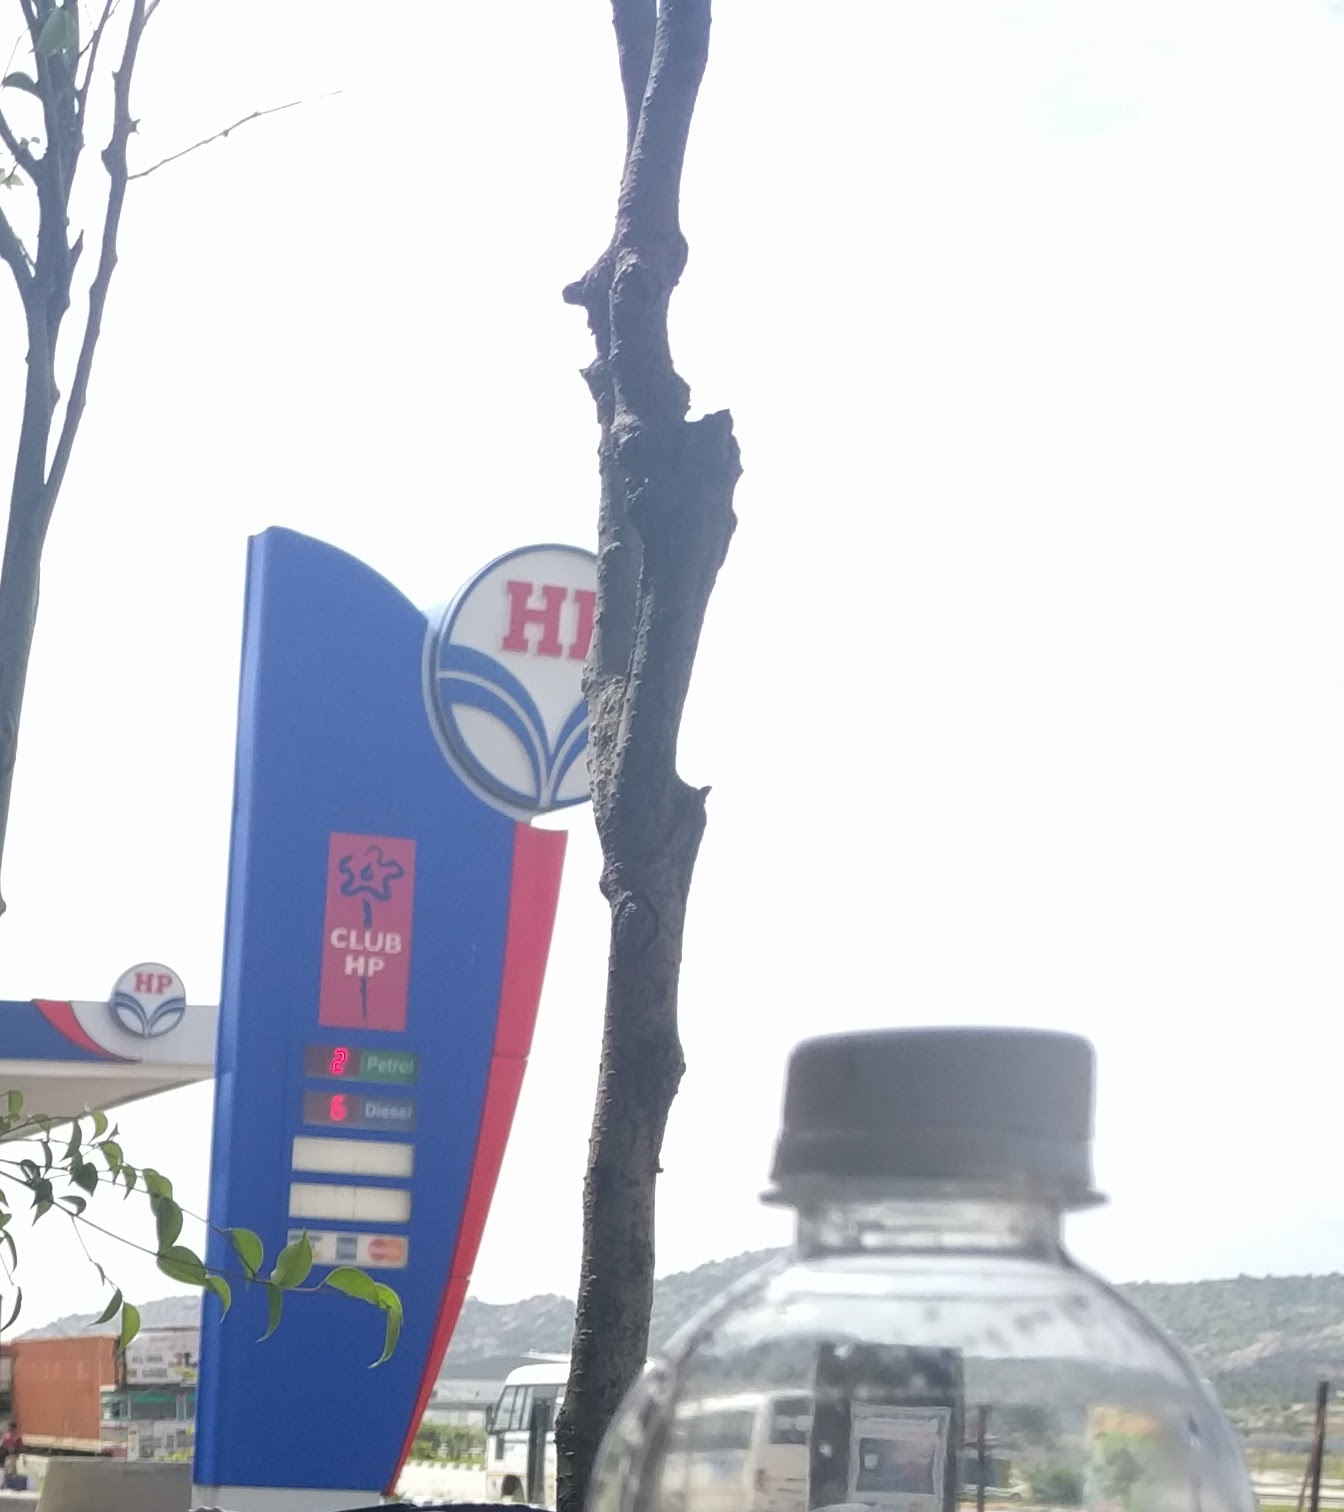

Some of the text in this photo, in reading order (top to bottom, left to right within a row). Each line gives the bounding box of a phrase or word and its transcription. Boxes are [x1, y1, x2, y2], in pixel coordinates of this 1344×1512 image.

[330, 927, 402, 954] CLUB
[344, 954, 385, 978] HP
[133, 971, 174, 995] HP
[366, 1055, 415, 1075] Petrol
[364, 1101, 413, 1120] Diesel
